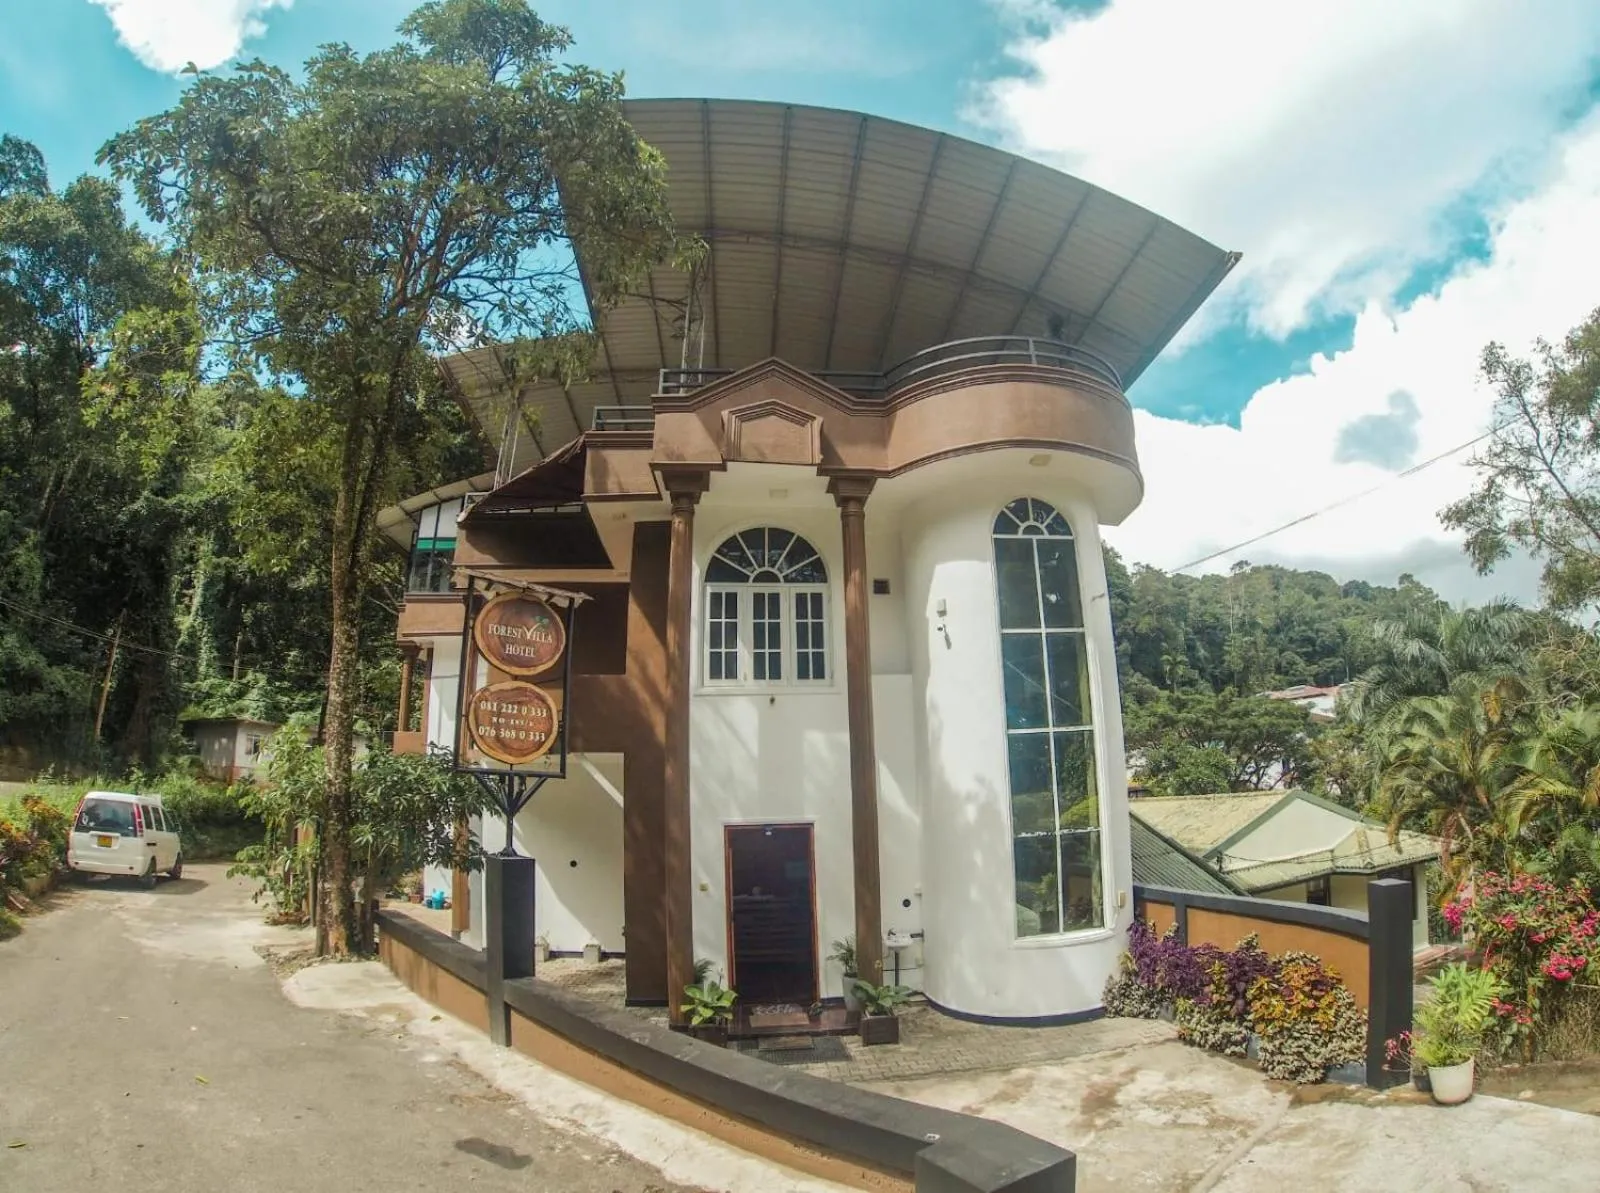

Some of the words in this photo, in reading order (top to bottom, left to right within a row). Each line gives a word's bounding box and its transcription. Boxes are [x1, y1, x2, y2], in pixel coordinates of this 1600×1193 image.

[488, 624, 521, 638] FOREST
[522, 623, 552, 642] VILLA
[504, 643, 535, 657] HOTEL
[521, 706, 528, 716] 0
[531, 707, 547, 717] 333
[478, 725, 496, 737] 076
[519, 730, 526, 740] 0
[528, 732, 546, 742] 333
